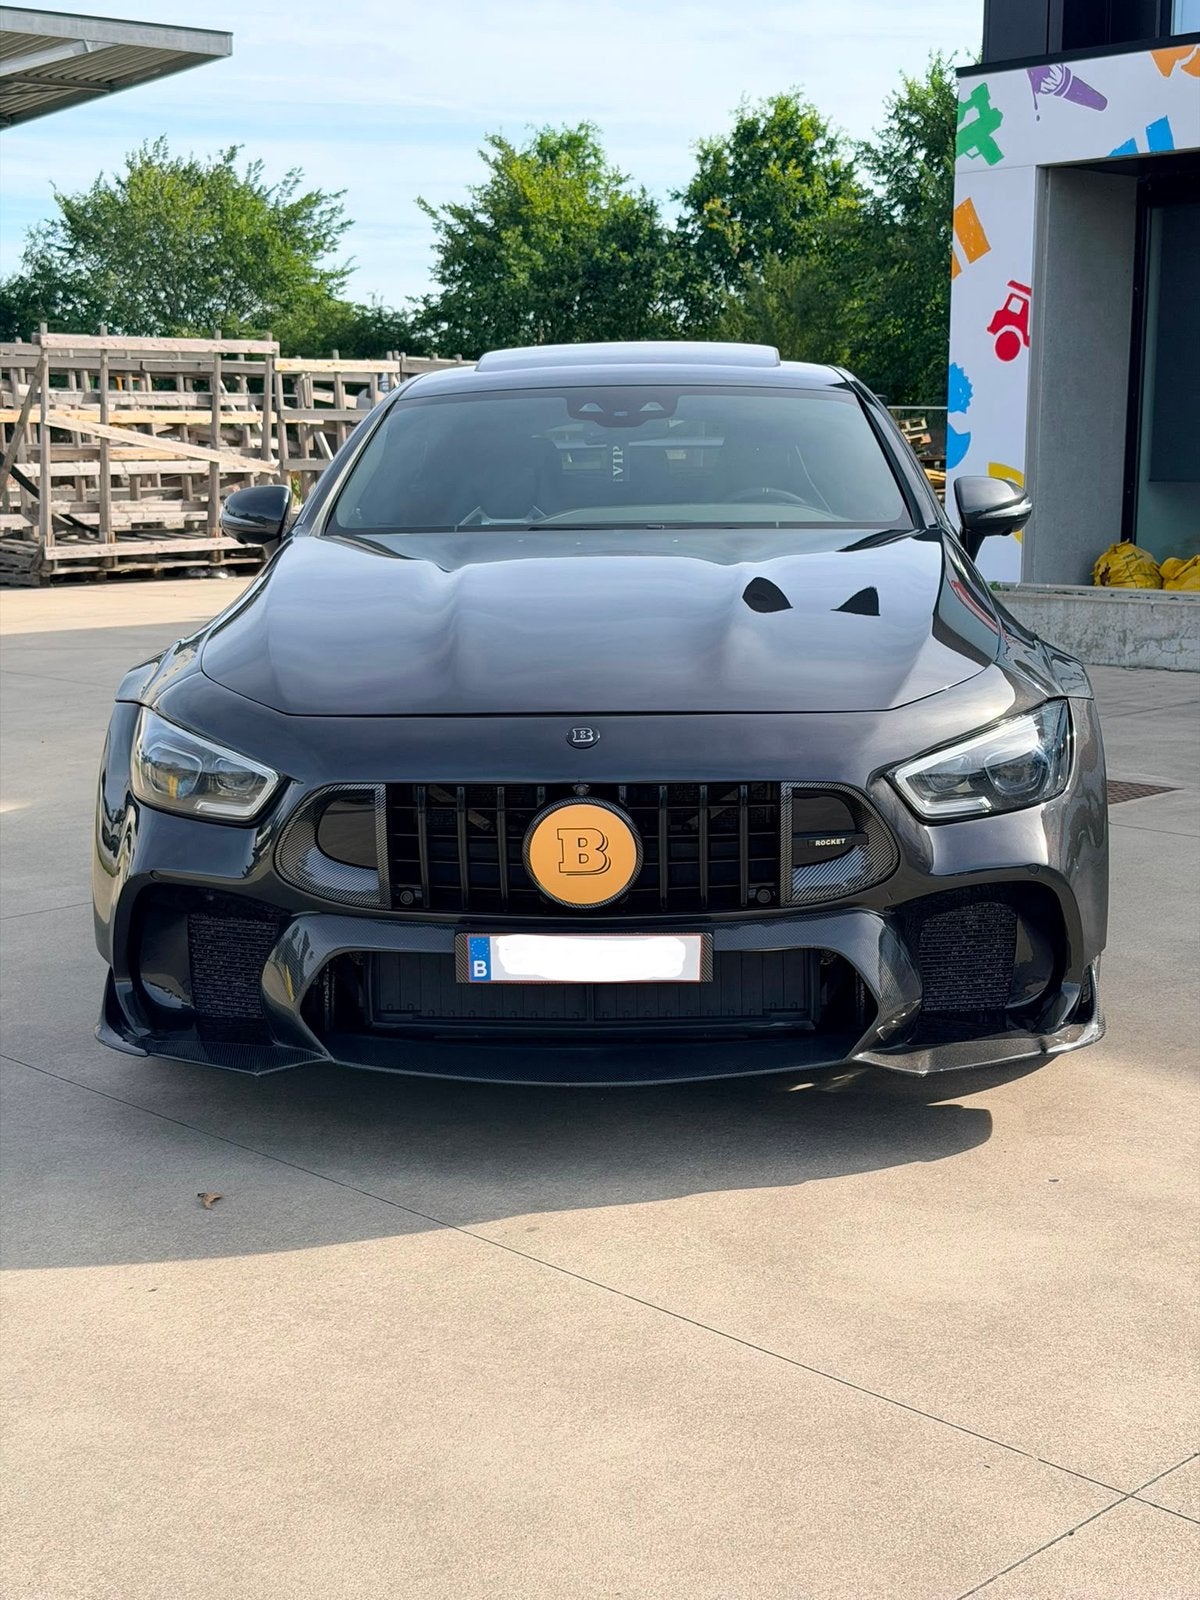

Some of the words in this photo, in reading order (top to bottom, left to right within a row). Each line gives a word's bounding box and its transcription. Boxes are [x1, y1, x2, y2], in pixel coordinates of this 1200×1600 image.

[573, 728, 593, 742] B
[815, 838, 846, 846] ROCKET
[557, 828, 611, 875] B
[473, 960, 488, 977] B
